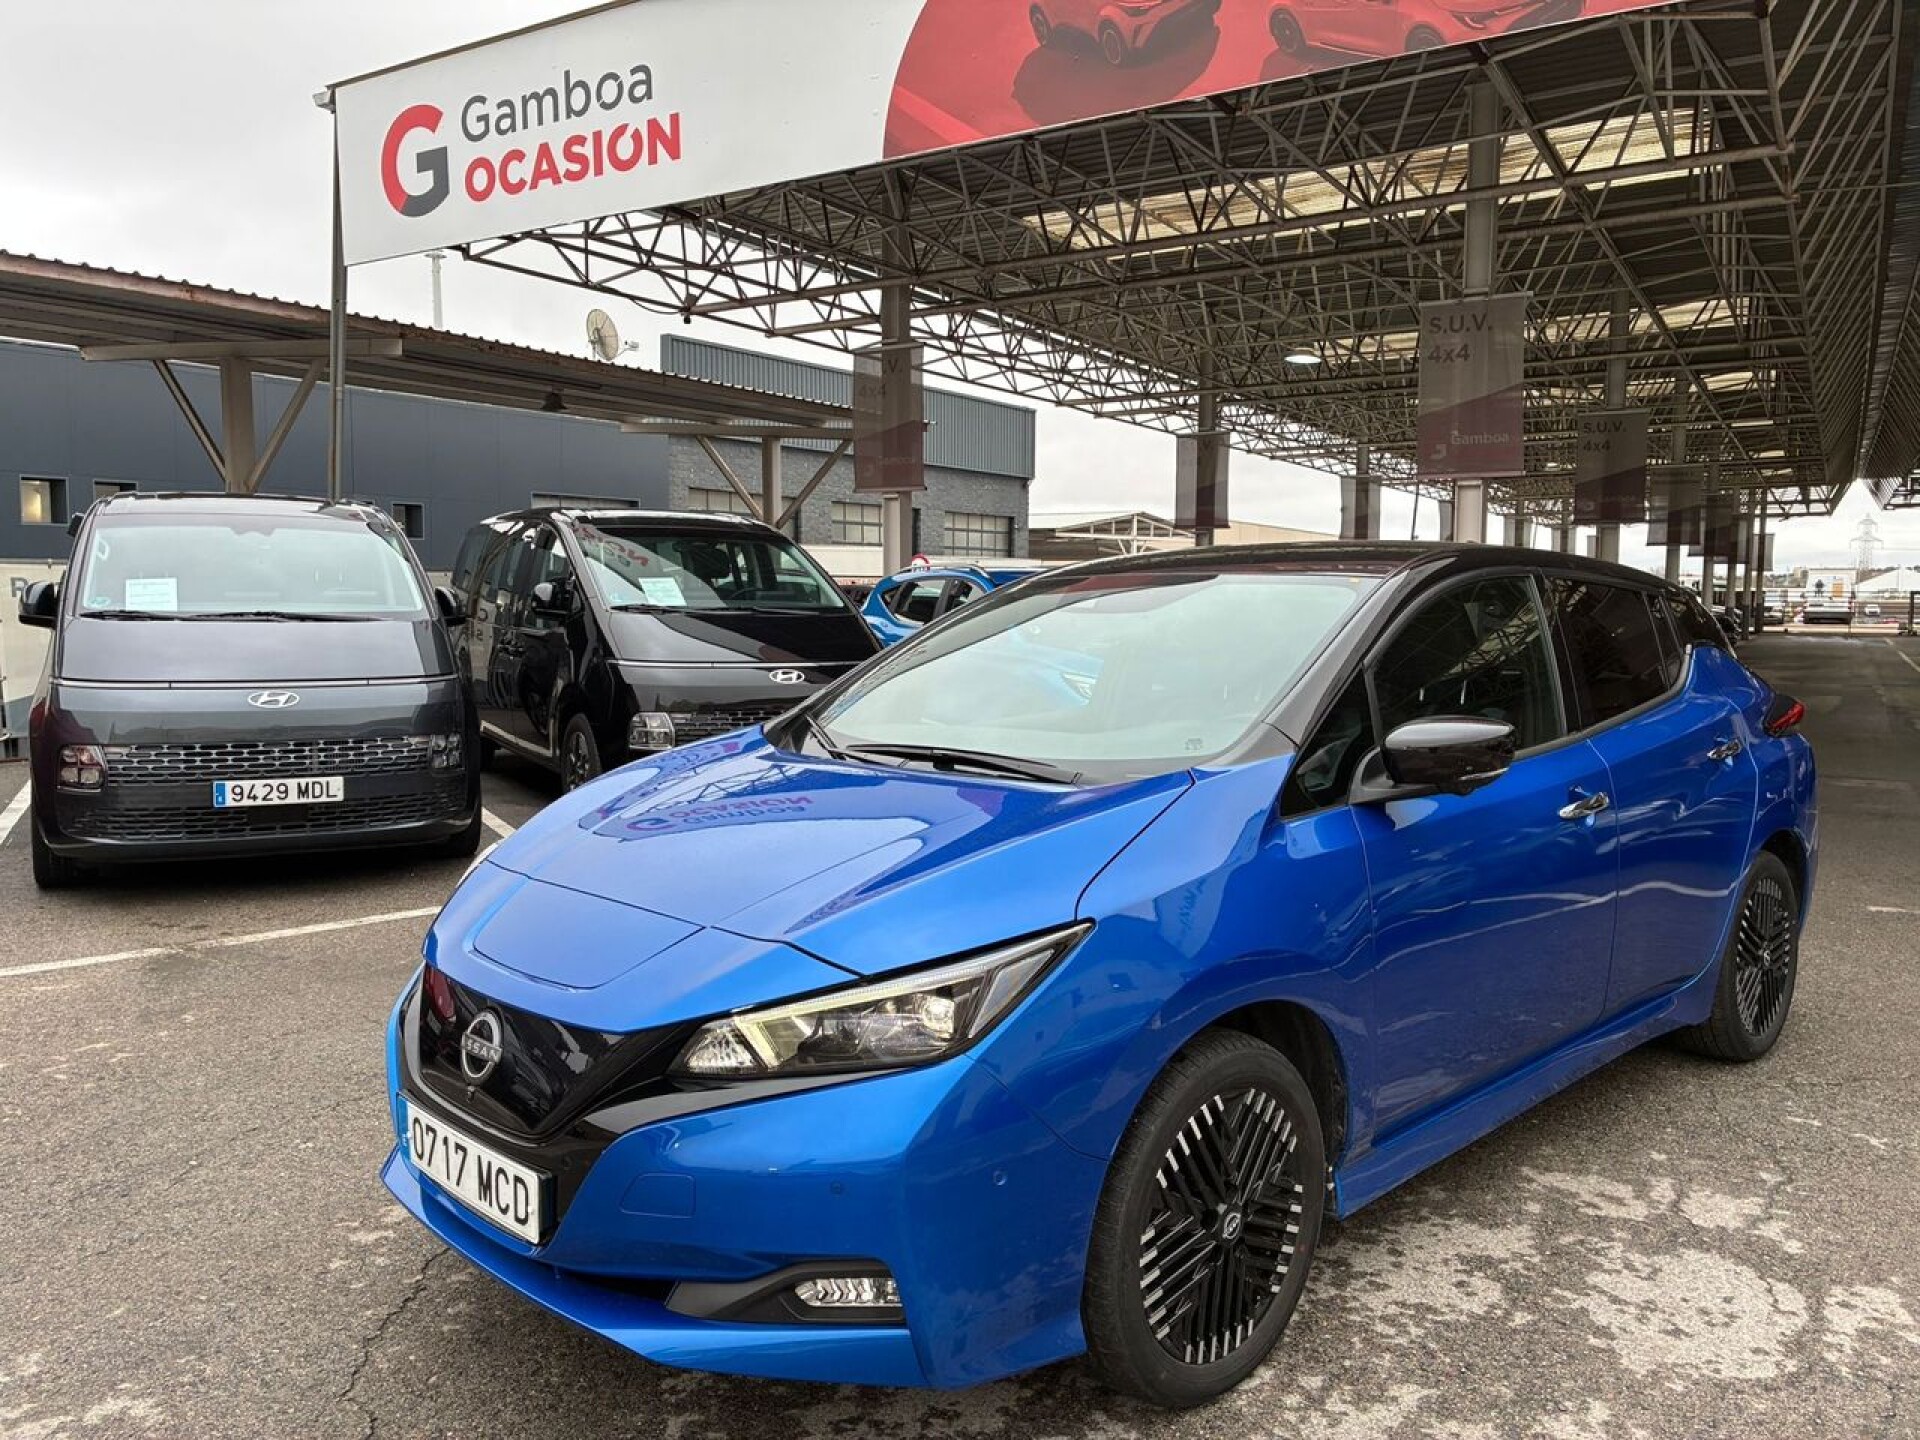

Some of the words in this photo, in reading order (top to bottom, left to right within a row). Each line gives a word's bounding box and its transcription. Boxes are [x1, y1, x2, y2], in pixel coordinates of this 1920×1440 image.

[461, 64, 653, 142] Gamboa
[1429, 312, 1492, 335] S.U.V.
[1428, 344, 1471, 364] 4x4
[231, 782, 289, 802] 9429
[297, 780, 338, 799] MDL
[413, 1116, 468, 1187] 0717
[477, 1154, 529, 1226] MCD
